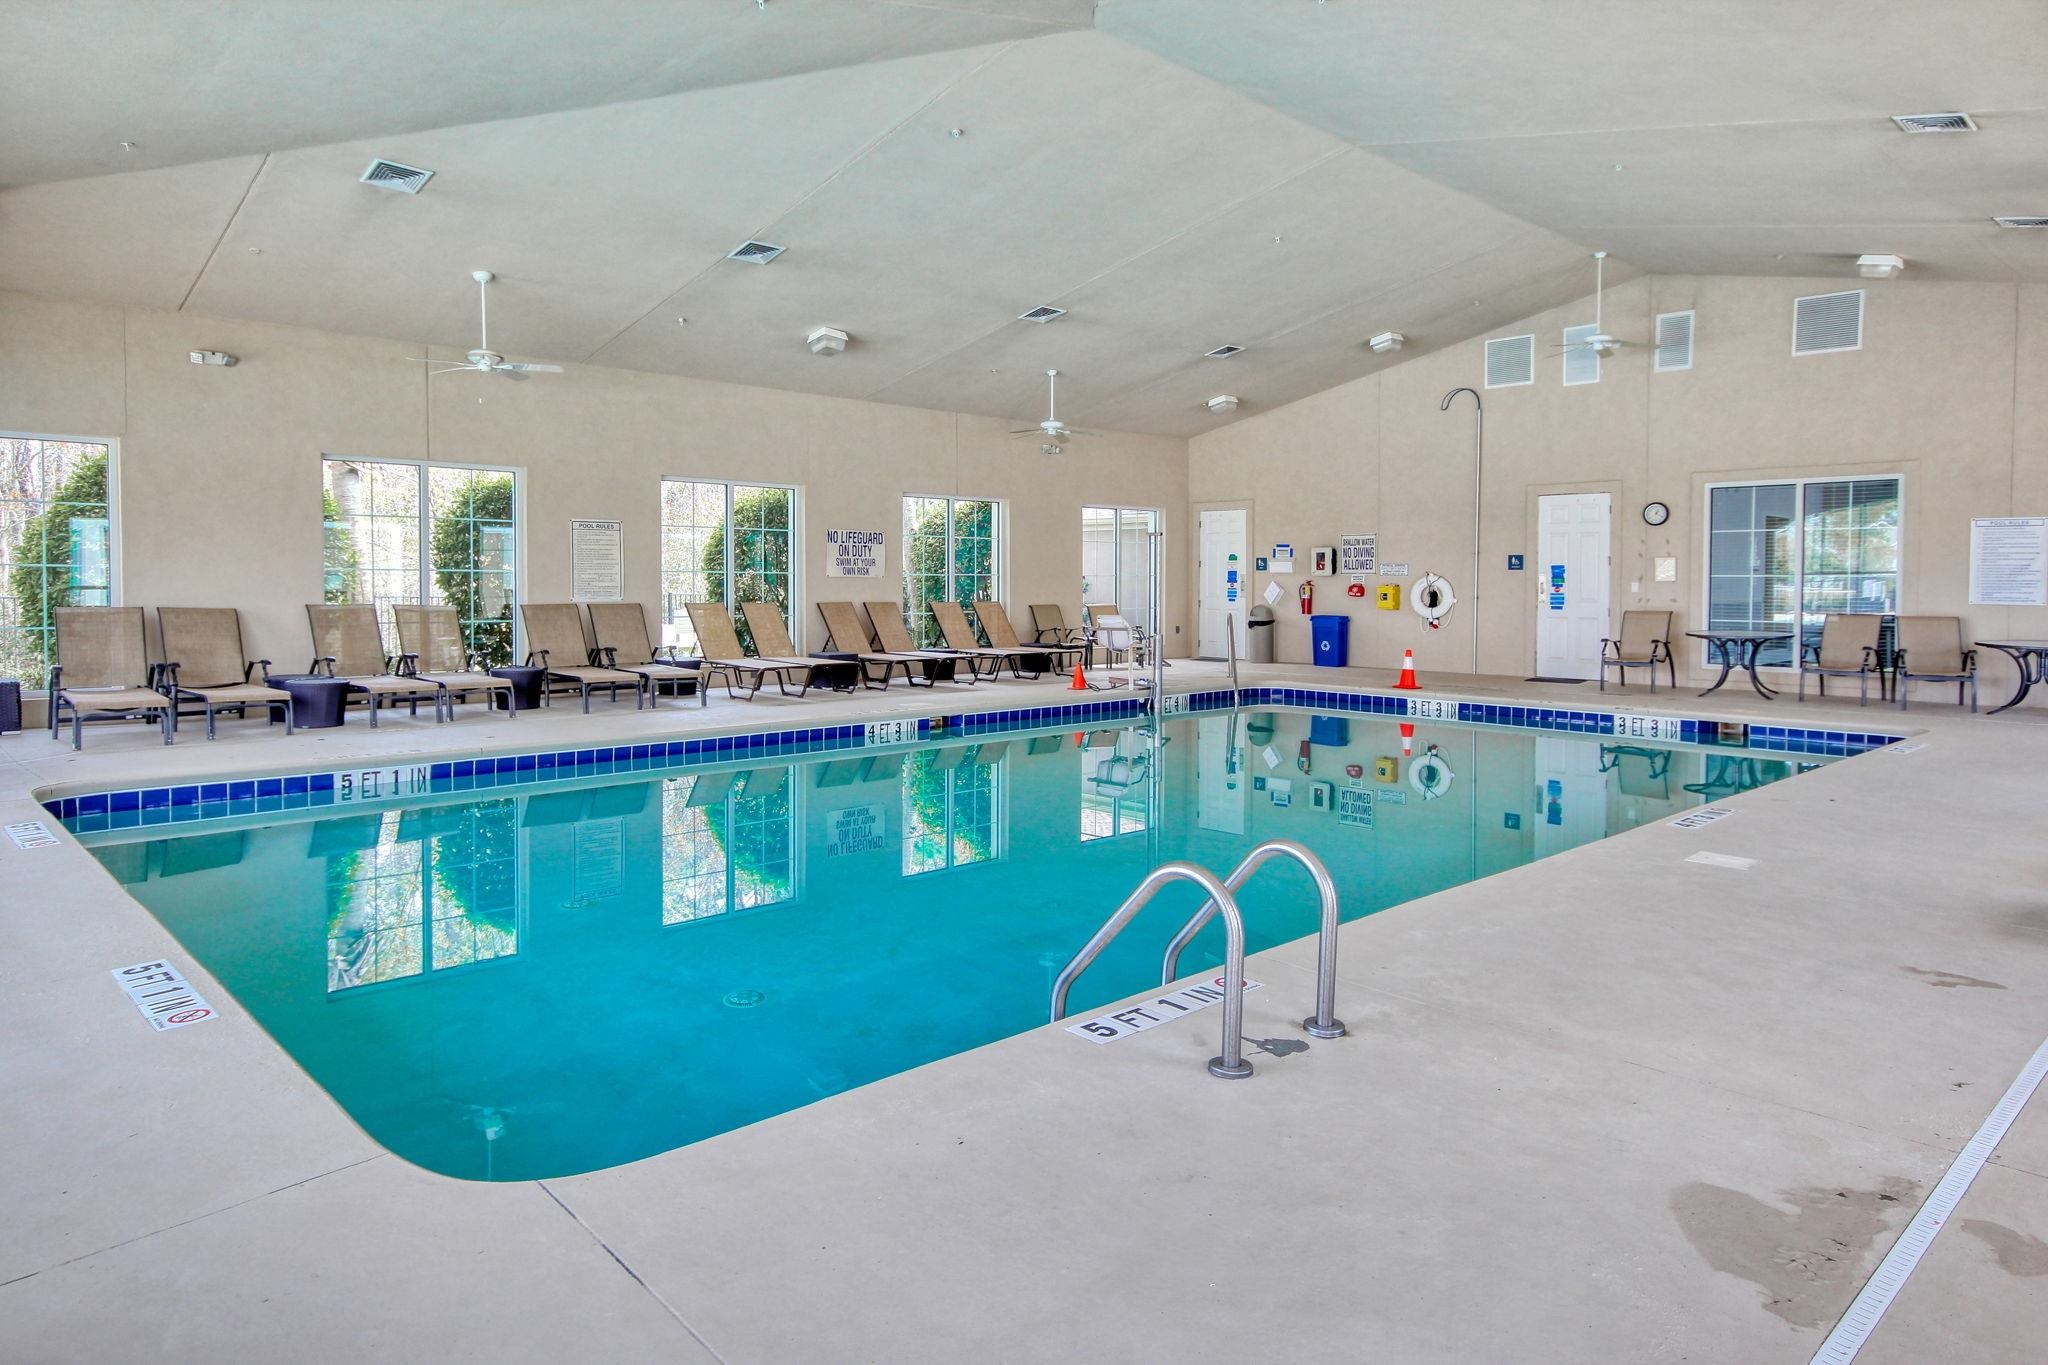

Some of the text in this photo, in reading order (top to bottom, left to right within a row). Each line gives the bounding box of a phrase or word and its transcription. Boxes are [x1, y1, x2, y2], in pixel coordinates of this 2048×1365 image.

[827, 529, 884, 544] NO LIFEGUARD
[1343, 538, 1374, 546] SHALLOW WATER
[838, 544, 872, 558] ON DUTY
[1343, 547, 1374, 558] NO DIVING
[836, 558, 876, 566] SWIM AT YOUR
[1344, 560, 1374, 570] ALLOWED
[842, 566, 870, 576] OWN RISK
[122, 963, 198, 1014] 5 FT 1 IN
[1080, 1022, 1118, 1038] 5
[1112, 1008, 1160, 1028] FT
[1158, 998, 1189, 1012] 1
[1182, 986, 1225, 1003] IN
